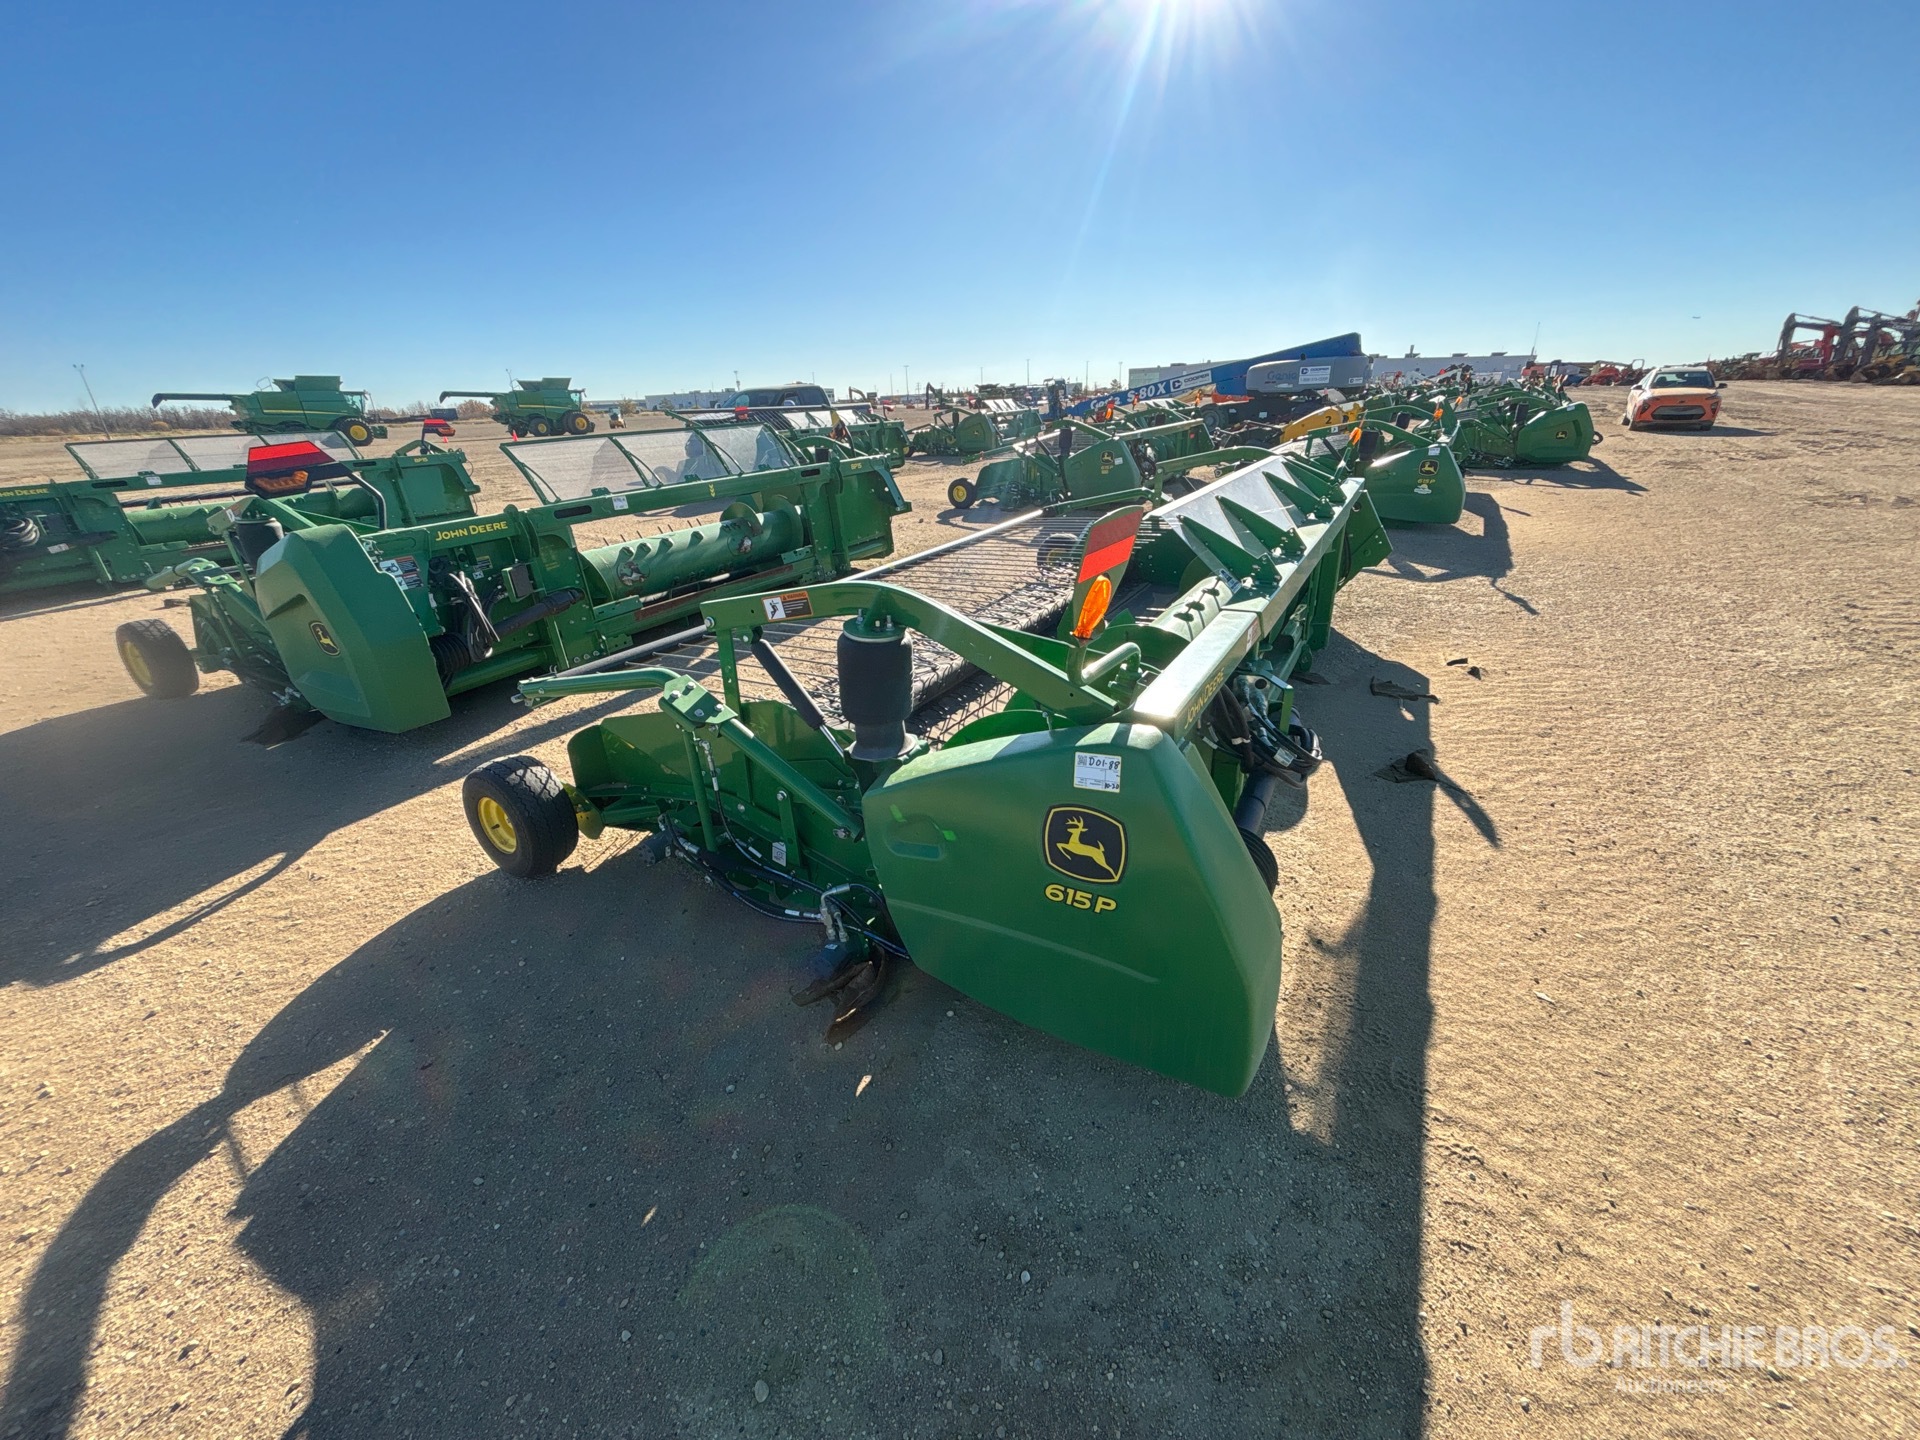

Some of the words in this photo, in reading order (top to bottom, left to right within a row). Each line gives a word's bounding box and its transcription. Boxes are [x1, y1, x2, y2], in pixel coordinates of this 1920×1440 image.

[1184, 372, 1210, 384] COOPER
[1325, 415, 1332, 424] 2
[15, 488, 49, 496] DEERE
[435, 528, 468, 542] JOHN
[469, 521, 508, 535] DEERE
[1184, 694, 1204, 730] JOHN
[1203, 667, 1225, 704] DEERE
